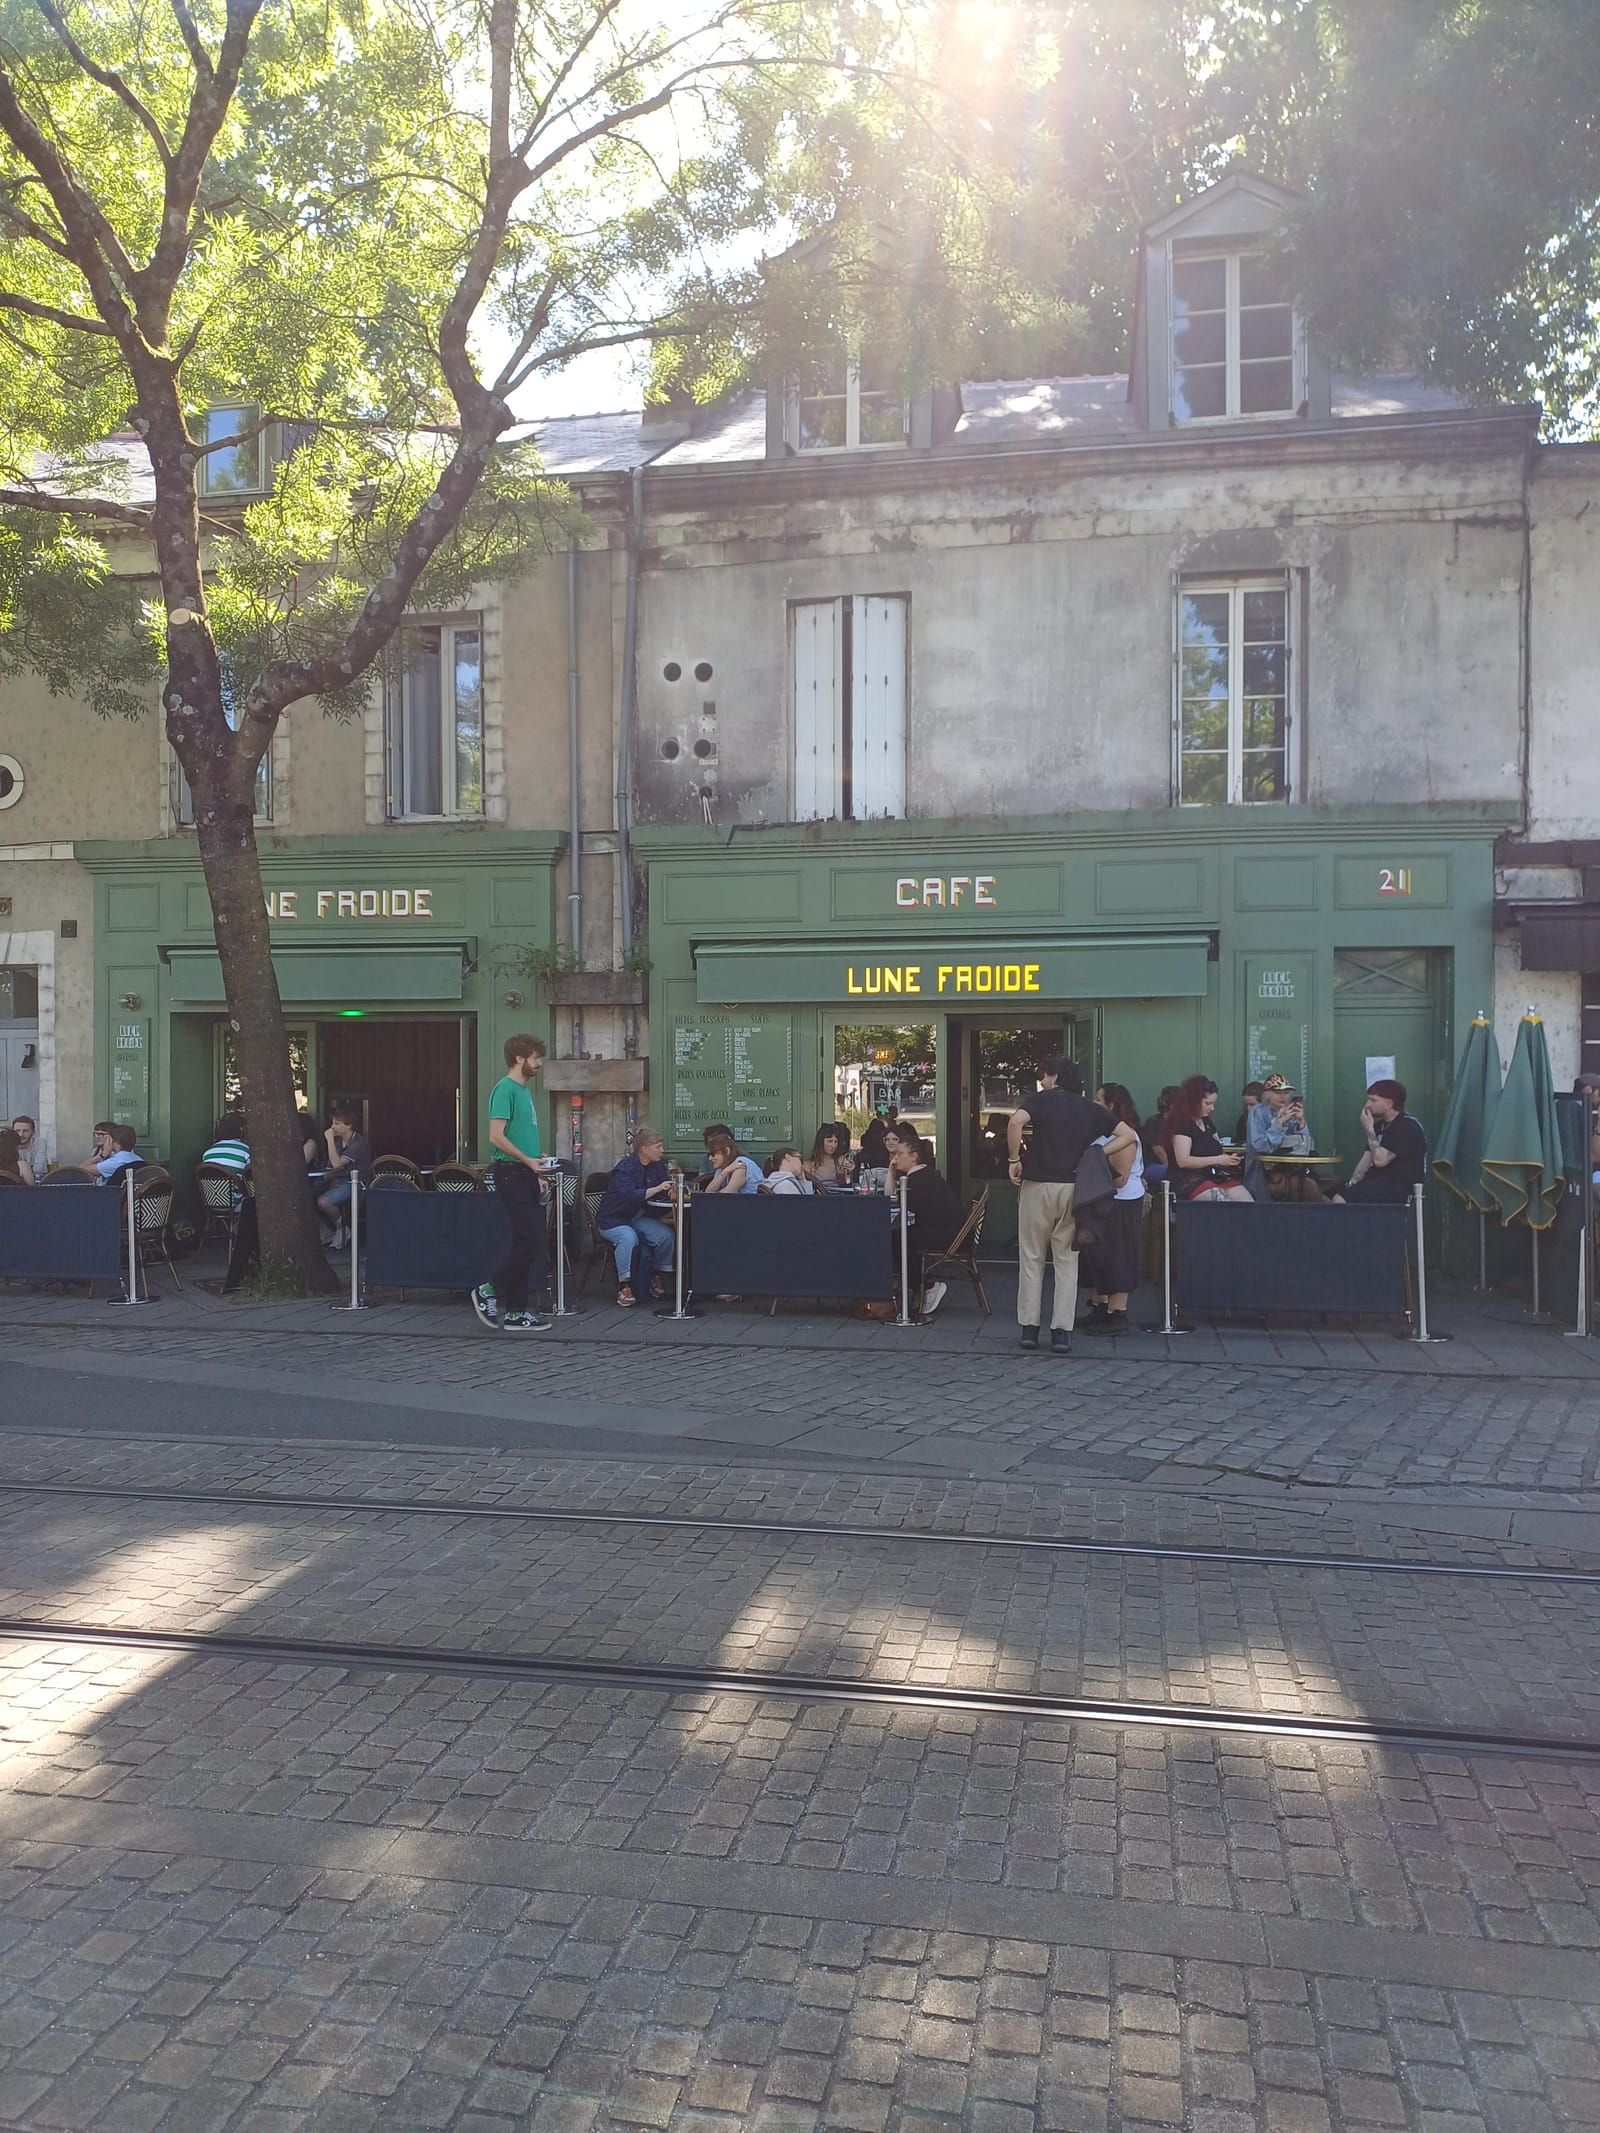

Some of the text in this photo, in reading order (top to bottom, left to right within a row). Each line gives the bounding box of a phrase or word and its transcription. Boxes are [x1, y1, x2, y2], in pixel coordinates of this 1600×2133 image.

[896, 876, 997, 908] CAFE
[1377, 868, 1411, 896] 21
[265, 889, 433, 920] NE FROIDE
[847, 963, 1041, 994] LUNE FROIDE
[879, 1088, 901, 1100] BAR
